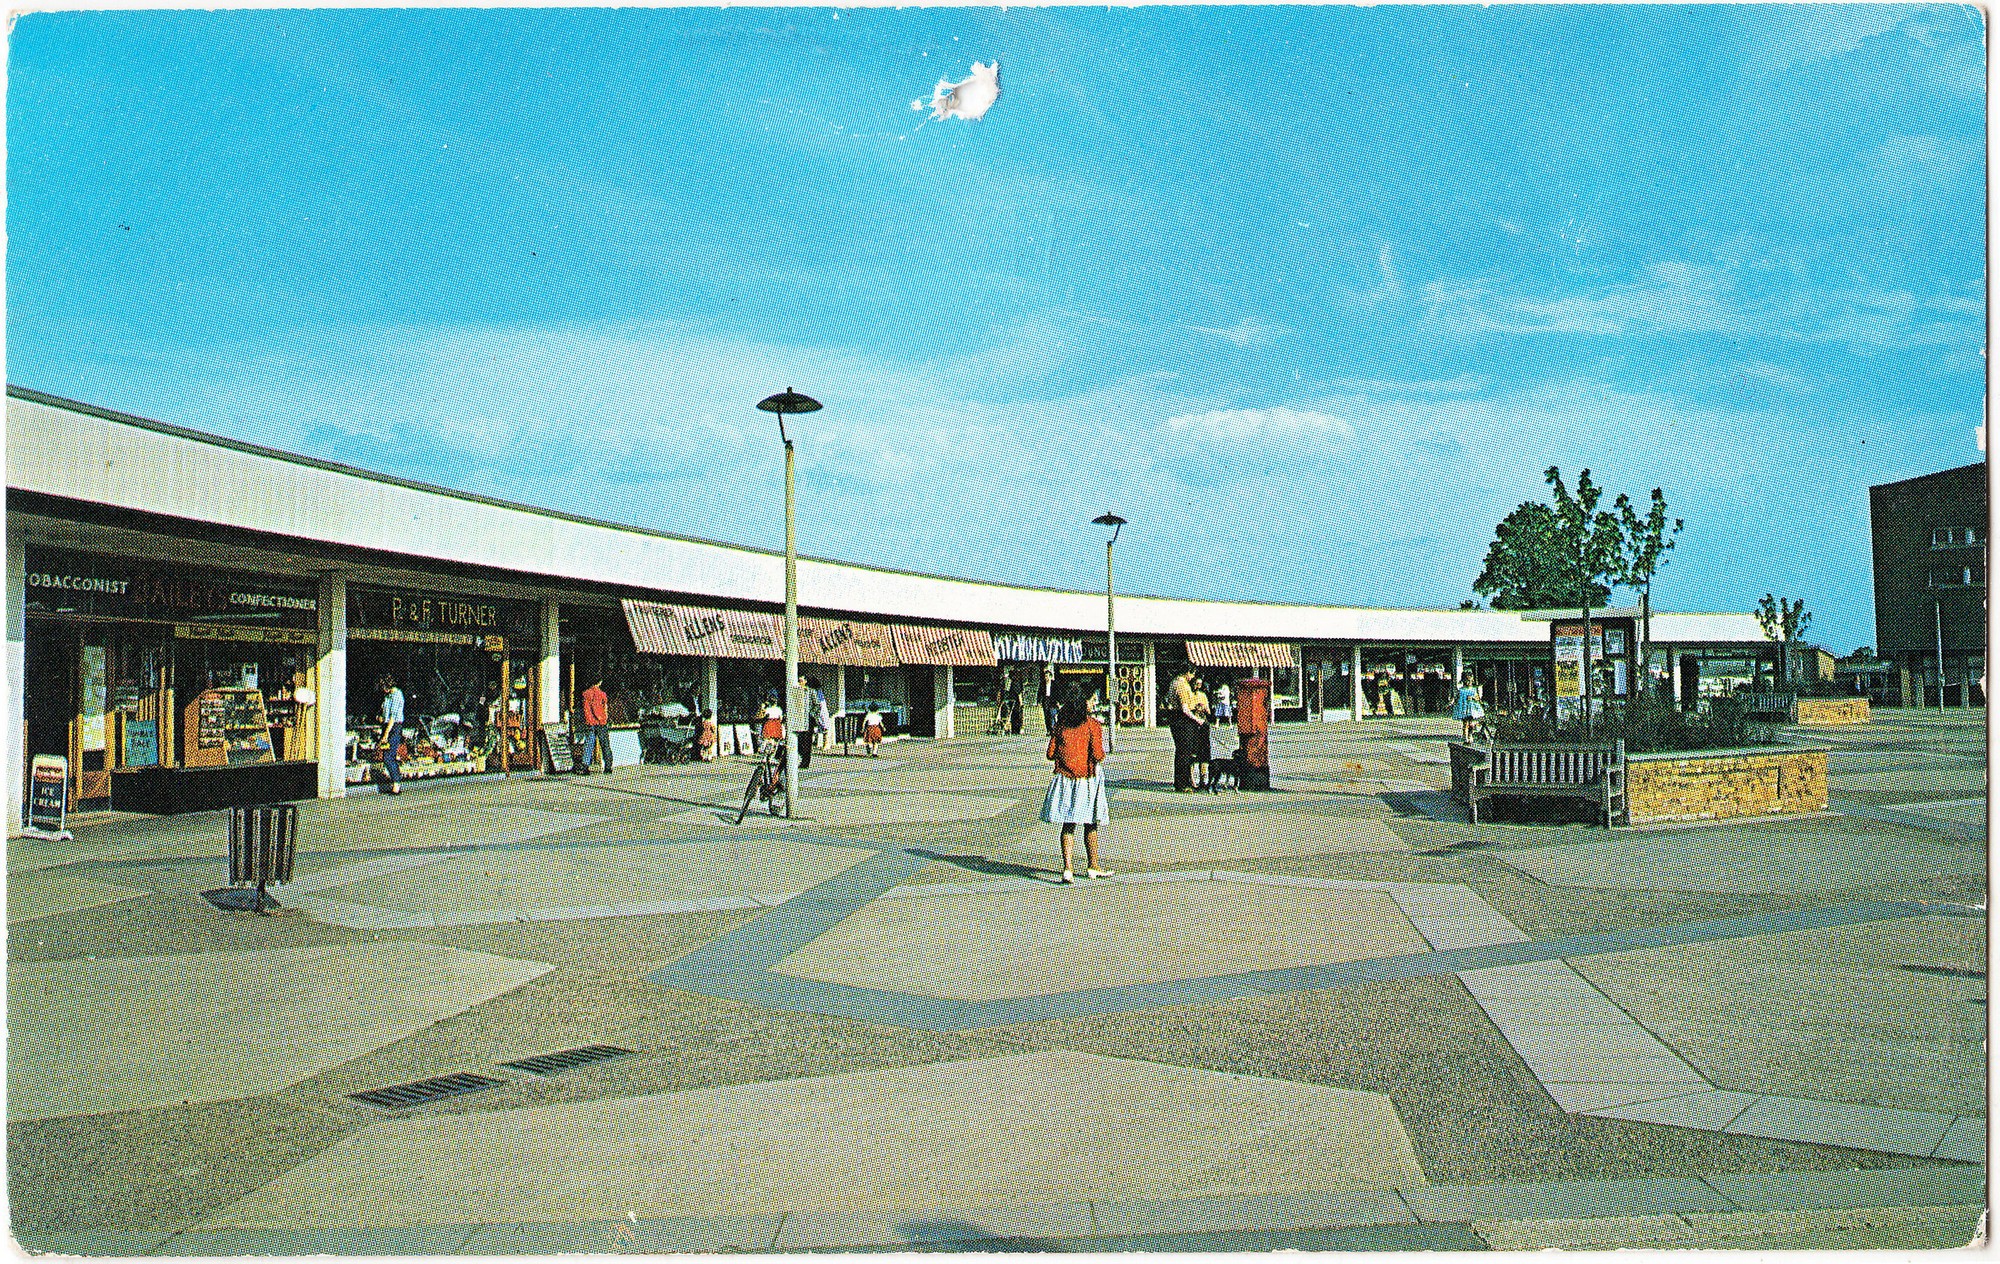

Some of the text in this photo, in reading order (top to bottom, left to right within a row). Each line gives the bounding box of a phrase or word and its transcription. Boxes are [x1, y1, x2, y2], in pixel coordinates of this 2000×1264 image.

[26, 573, 128, 594] OBACCONIST
[231, 592, 316, 610] CONFECTIONER
[409, 604, 419, 621] &
[438, 602, 497, 626] TURNER
[41, 786, 55, 797] ICE
[33, 798, 61, 808] CREAM
